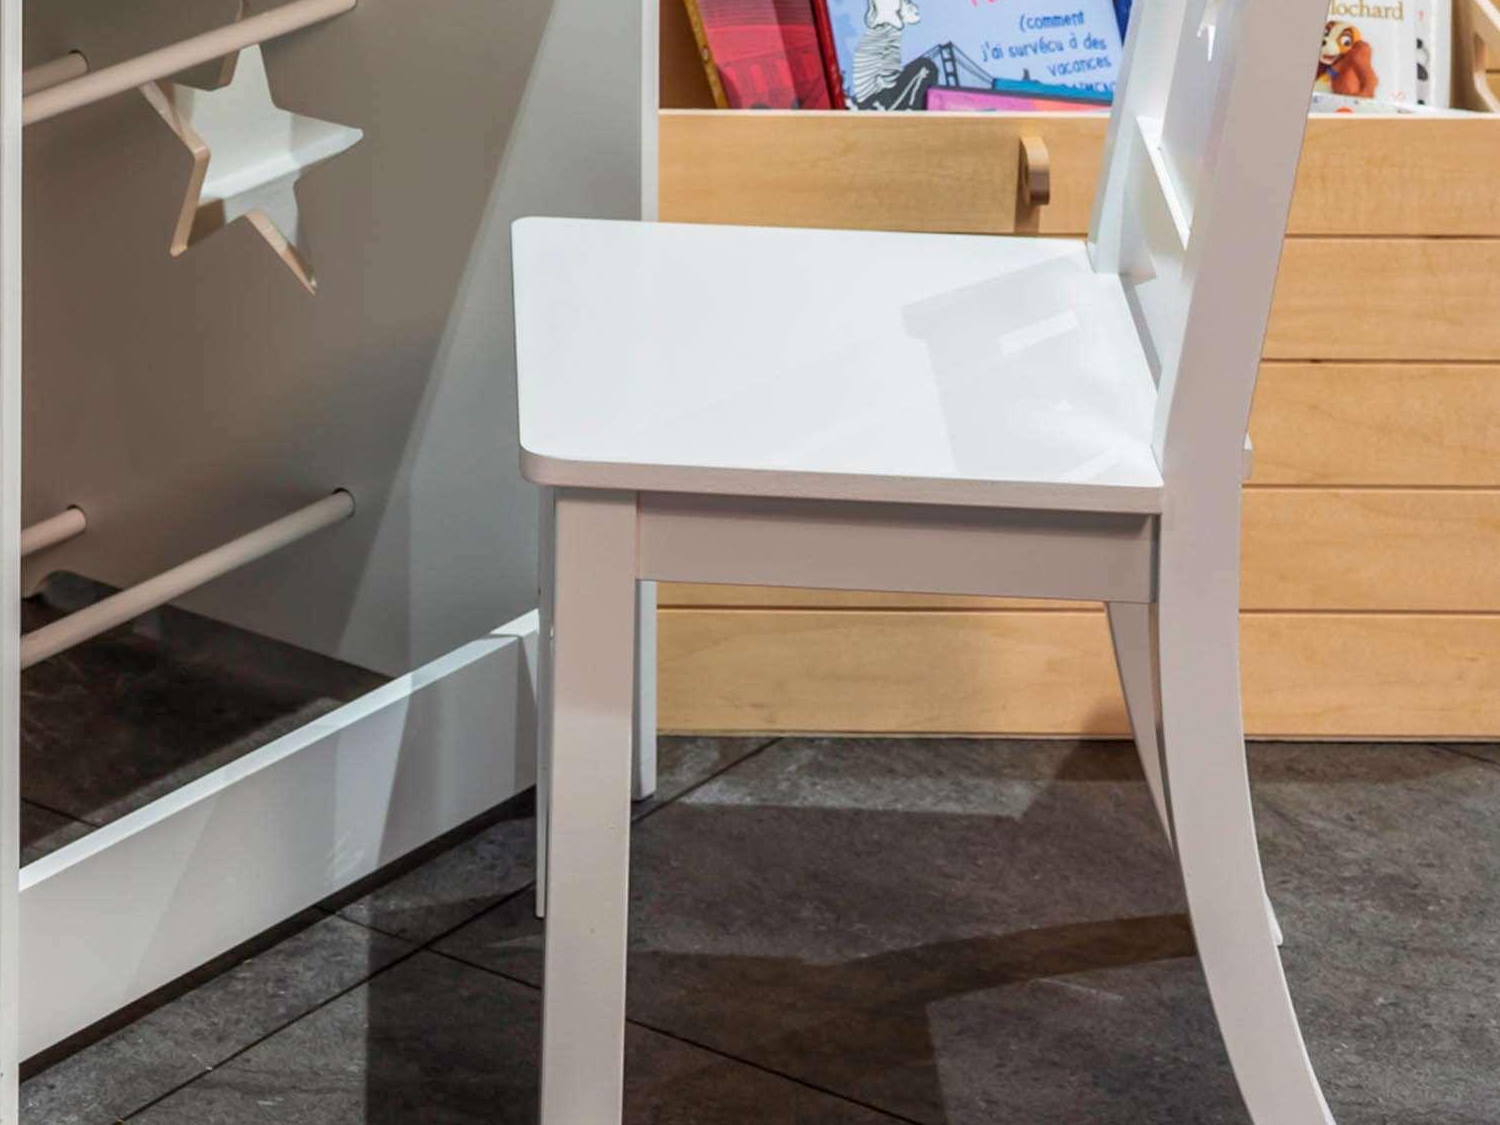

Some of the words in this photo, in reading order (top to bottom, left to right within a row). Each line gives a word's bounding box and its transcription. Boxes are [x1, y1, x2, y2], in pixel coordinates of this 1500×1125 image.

[1018, 10, 1086, 33] (comment
[1008, 35, 1066, 59] survécu
[1082, 31, 1108, 52] des
[1046, 54, 1113, 77] vacances
